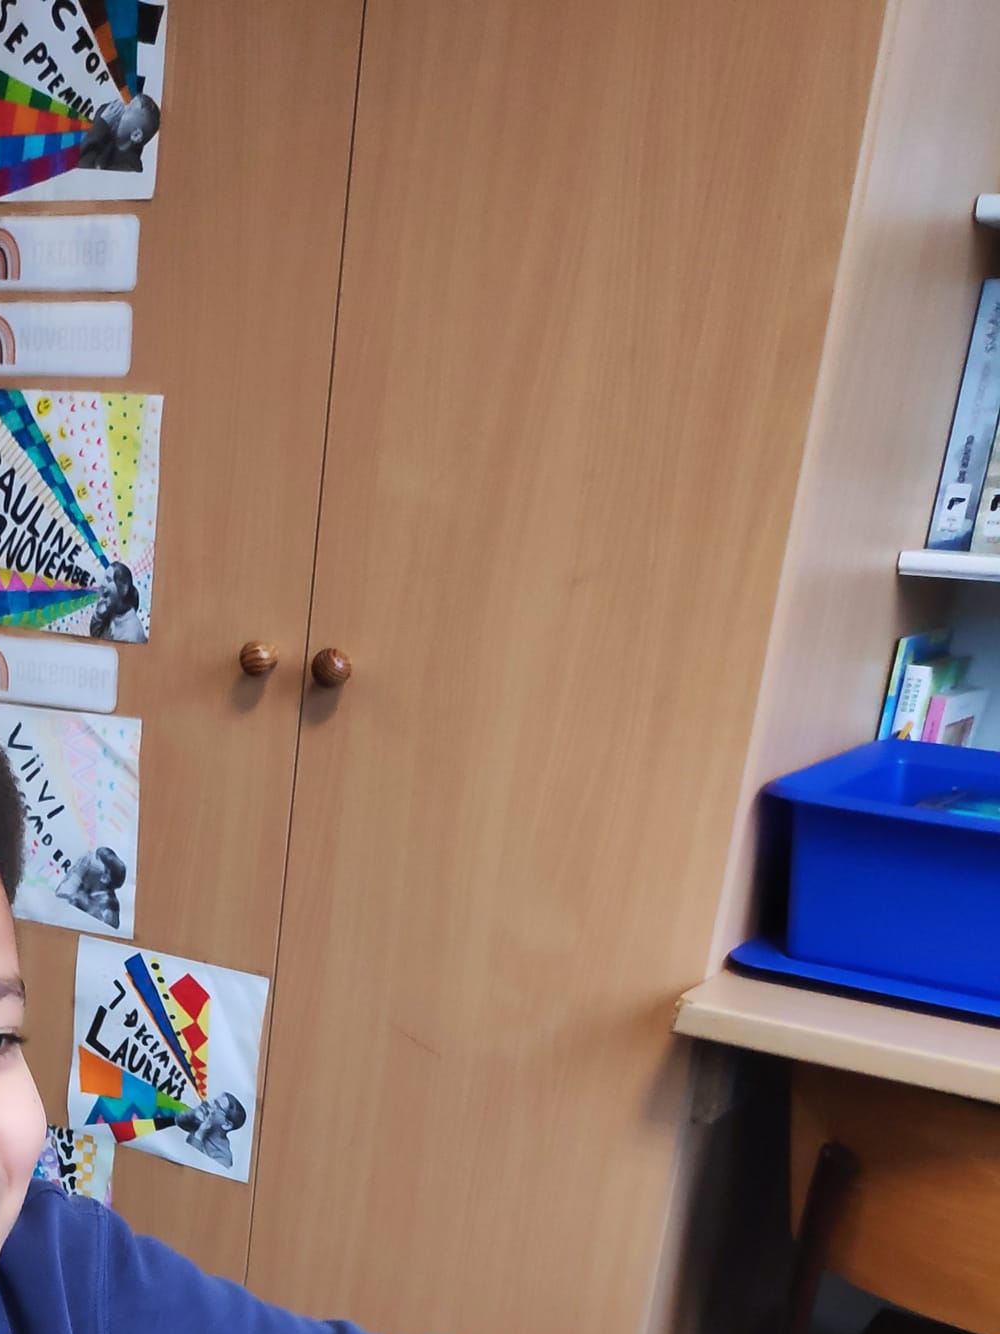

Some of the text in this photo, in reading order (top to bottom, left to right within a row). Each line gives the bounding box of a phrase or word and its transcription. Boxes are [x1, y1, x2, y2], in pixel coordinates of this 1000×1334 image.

[41, 0, 109, 85] CTOR
[109, 979, 127, 1010] 7
[85, 1004, 187, 1102] LAURENS
